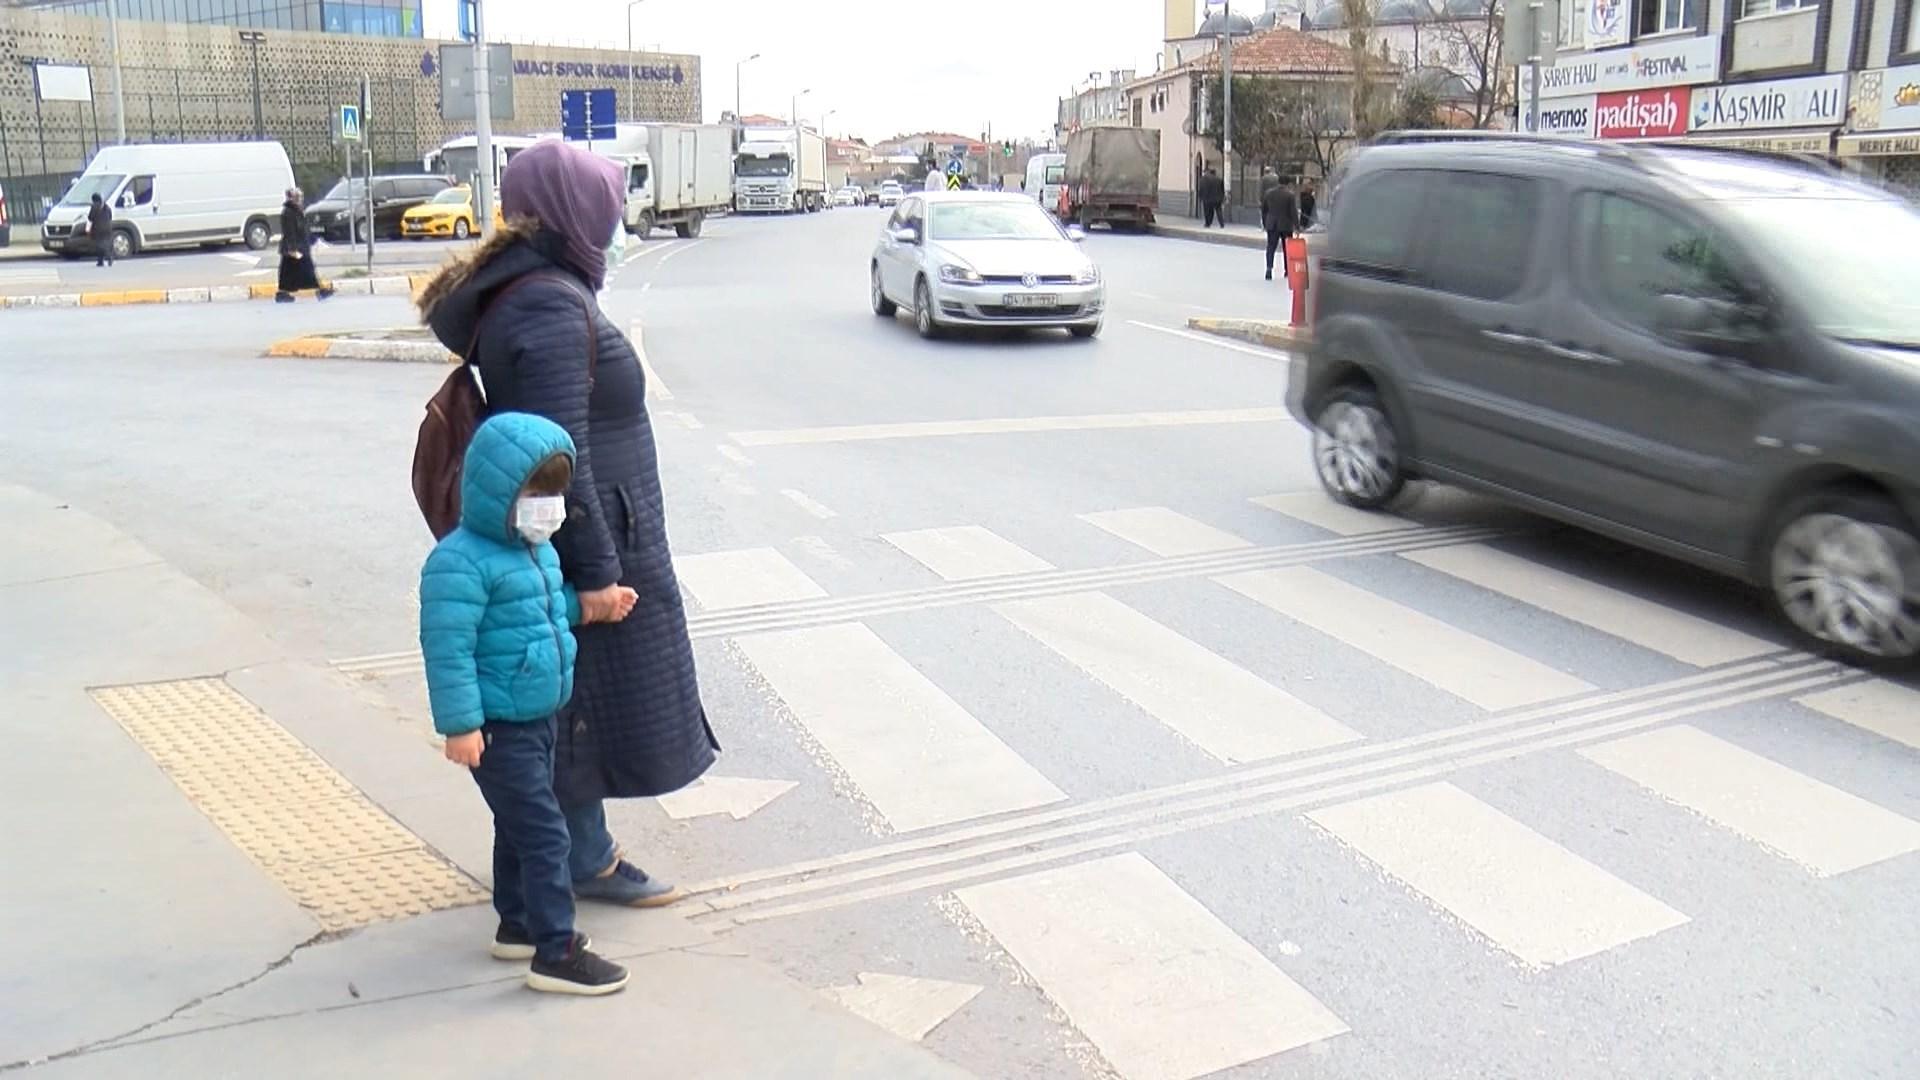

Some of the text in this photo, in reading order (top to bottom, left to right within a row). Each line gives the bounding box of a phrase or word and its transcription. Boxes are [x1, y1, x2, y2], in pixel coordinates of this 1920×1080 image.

[556, 61, 595, 78] SPOR
[1543, 67, 1571, 88] SARAY
[1597, 92, 1678, 136] padişah
[1712, 87, 1786, 126] KAŞMİR
[1541, 107, 1588, 129] merinos
[1859, 140, 1894, 153] MERVE
